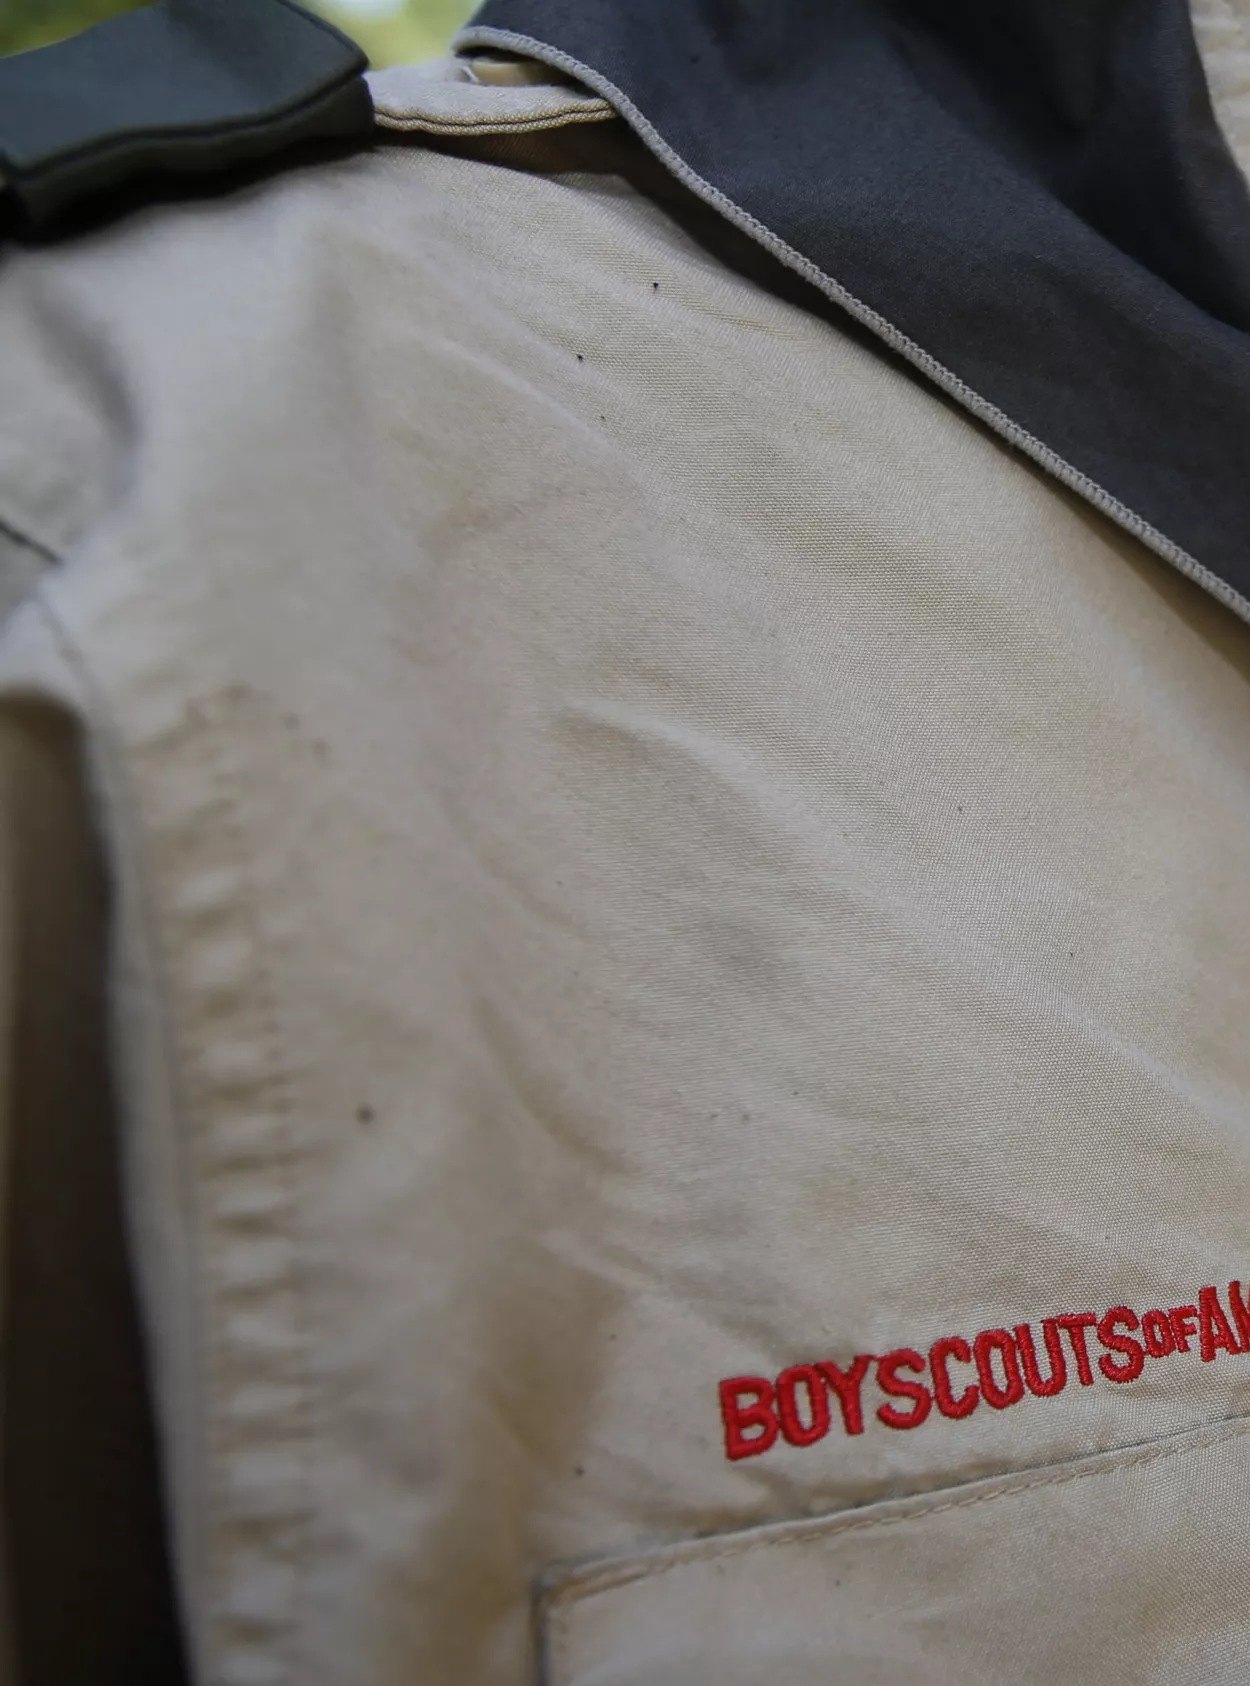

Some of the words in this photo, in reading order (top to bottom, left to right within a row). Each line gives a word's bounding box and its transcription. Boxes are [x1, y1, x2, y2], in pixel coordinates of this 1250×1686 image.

[719, 1354, 876, 1461] BOY
[876, 1306, 1144, 1430] SCOUTS
[1143, 1305, 1199, 1358] OF
